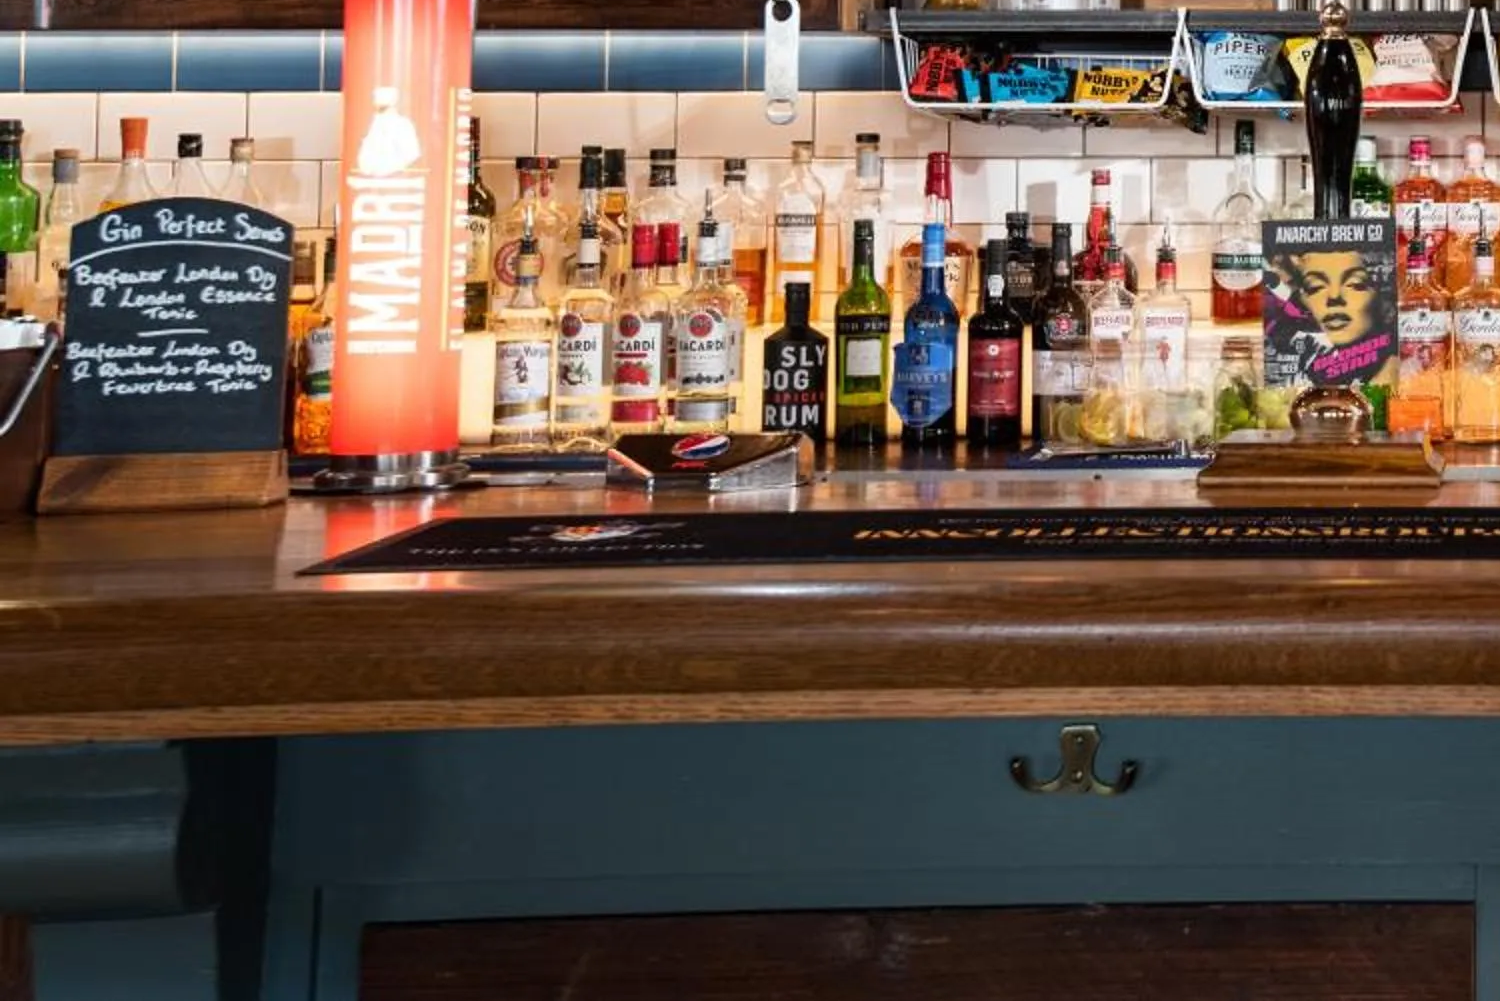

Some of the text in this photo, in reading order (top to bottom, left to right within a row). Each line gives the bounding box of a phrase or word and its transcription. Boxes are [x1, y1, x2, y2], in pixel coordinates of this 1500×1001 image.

[100, 213, 143, 243] Gin
[155, 207, 227, 238] Perfect
[1275, 226, 1329, 244] ANARCHY
[1331, 225, 1365, 243] BREW
[174, 262, 239, 284] London
[118, 286, 186, 309] London
[199, 286, 277, 304] Essence
[141, 305, 199, 320] Tonic
[161, 340, 221, 360] London
[780, 344, 827, 368] SLY
[204, 378, 258, 394] Tonic
[764, 403, 820, 427] RUM
